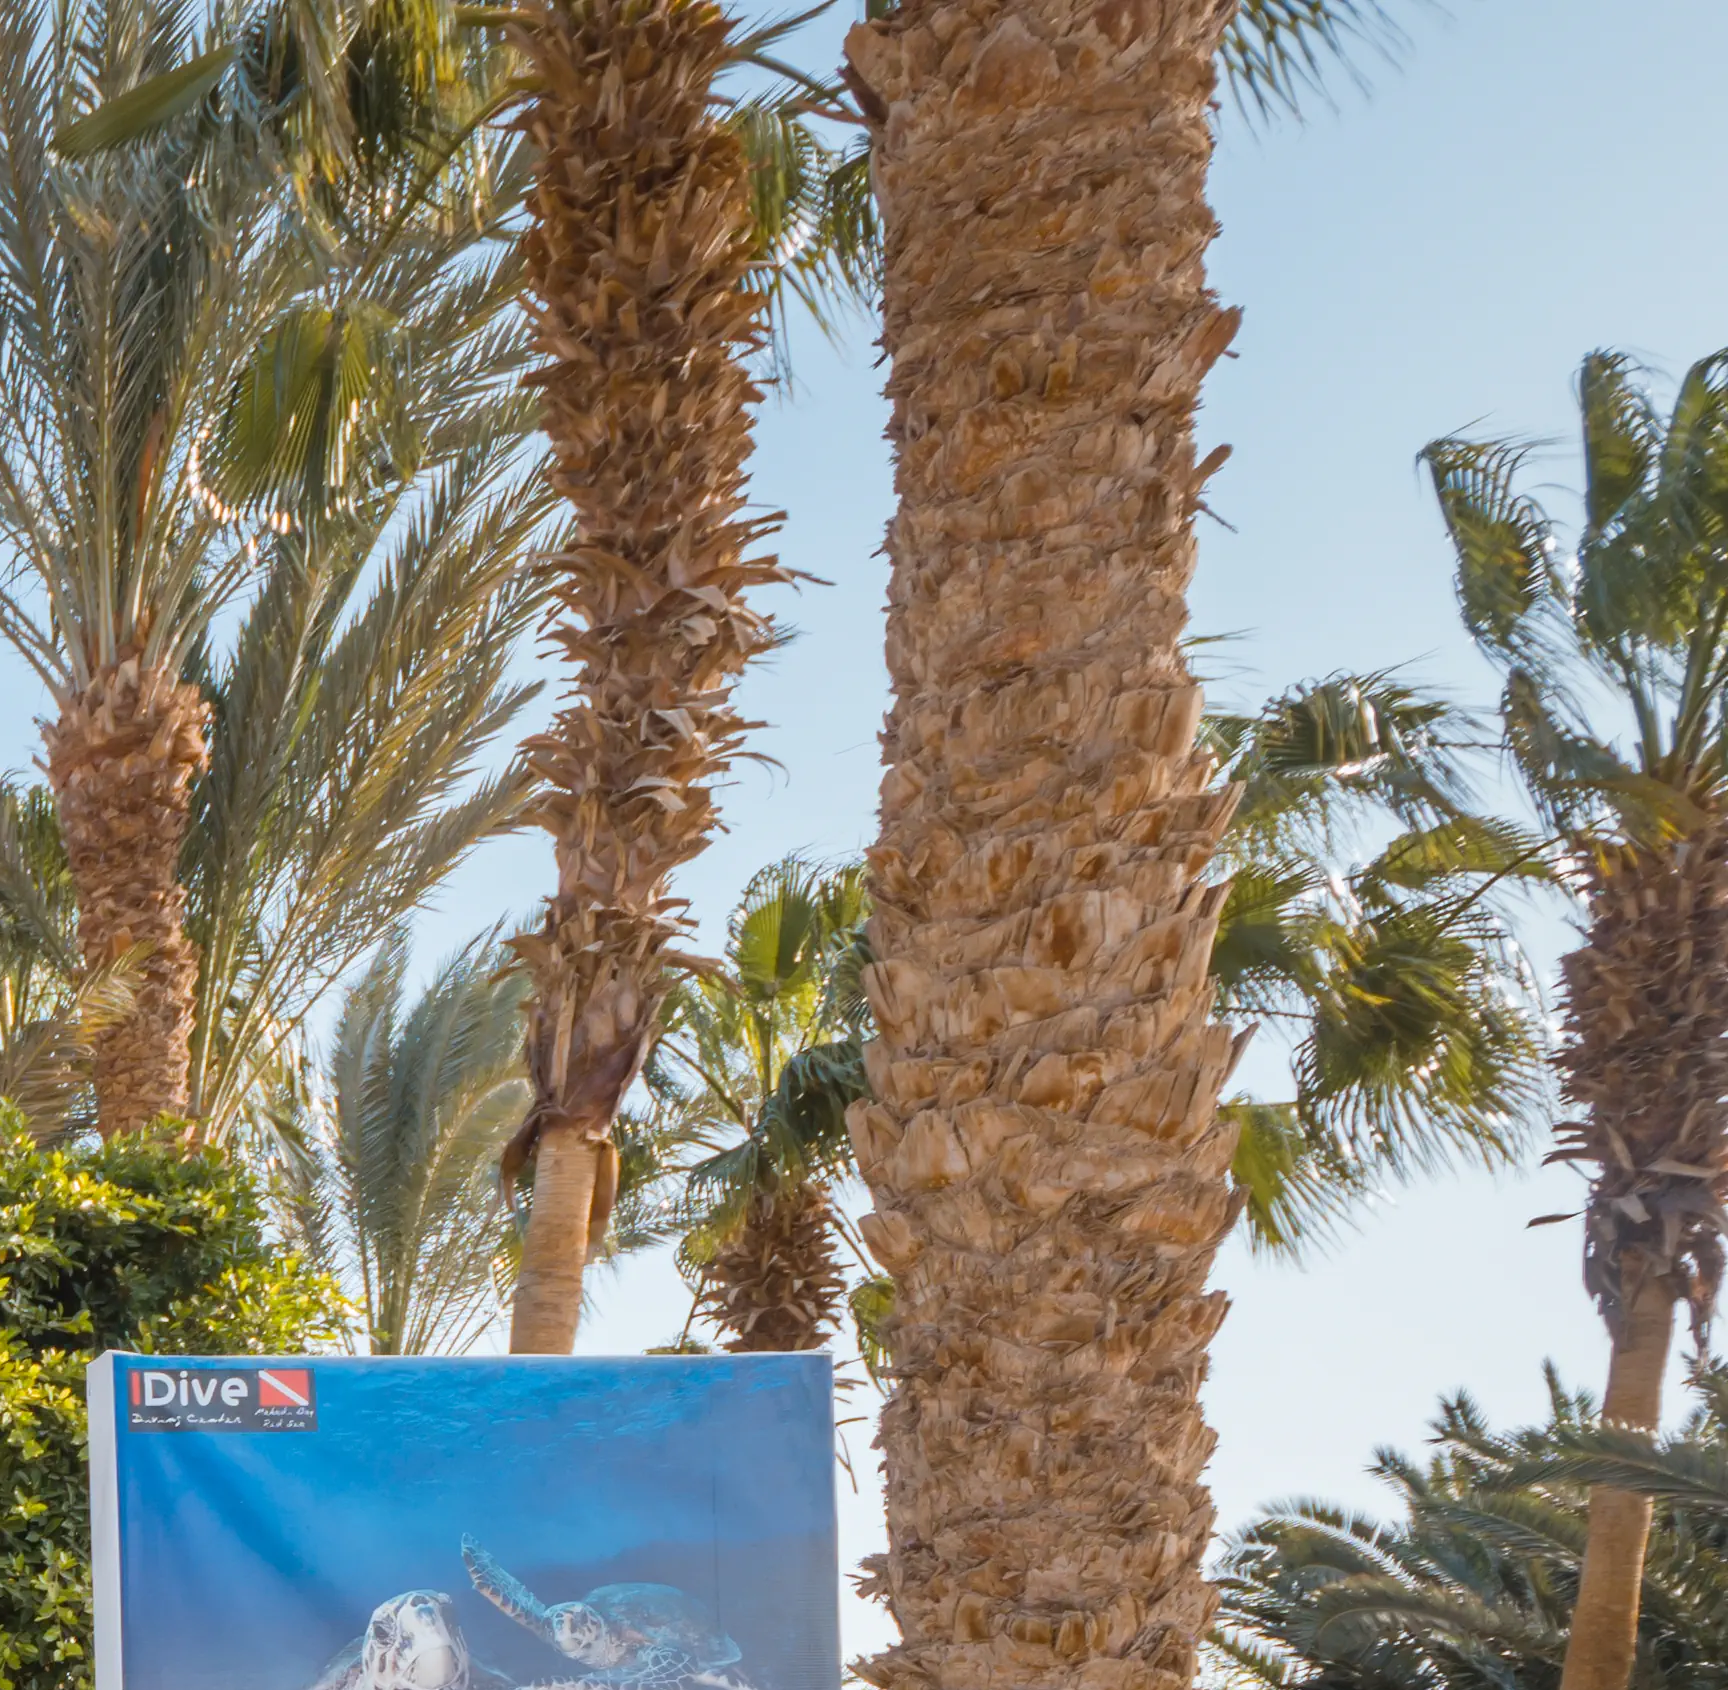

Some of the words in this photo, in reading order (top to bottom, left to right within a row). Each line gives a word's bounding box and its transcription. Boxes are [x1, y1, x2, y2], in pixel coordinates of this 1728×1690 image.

[131, 1371, 248, 1407] IDive
[132, 1412, 181, 1427] Diving
[186, 1413, 242, 1425] Center
